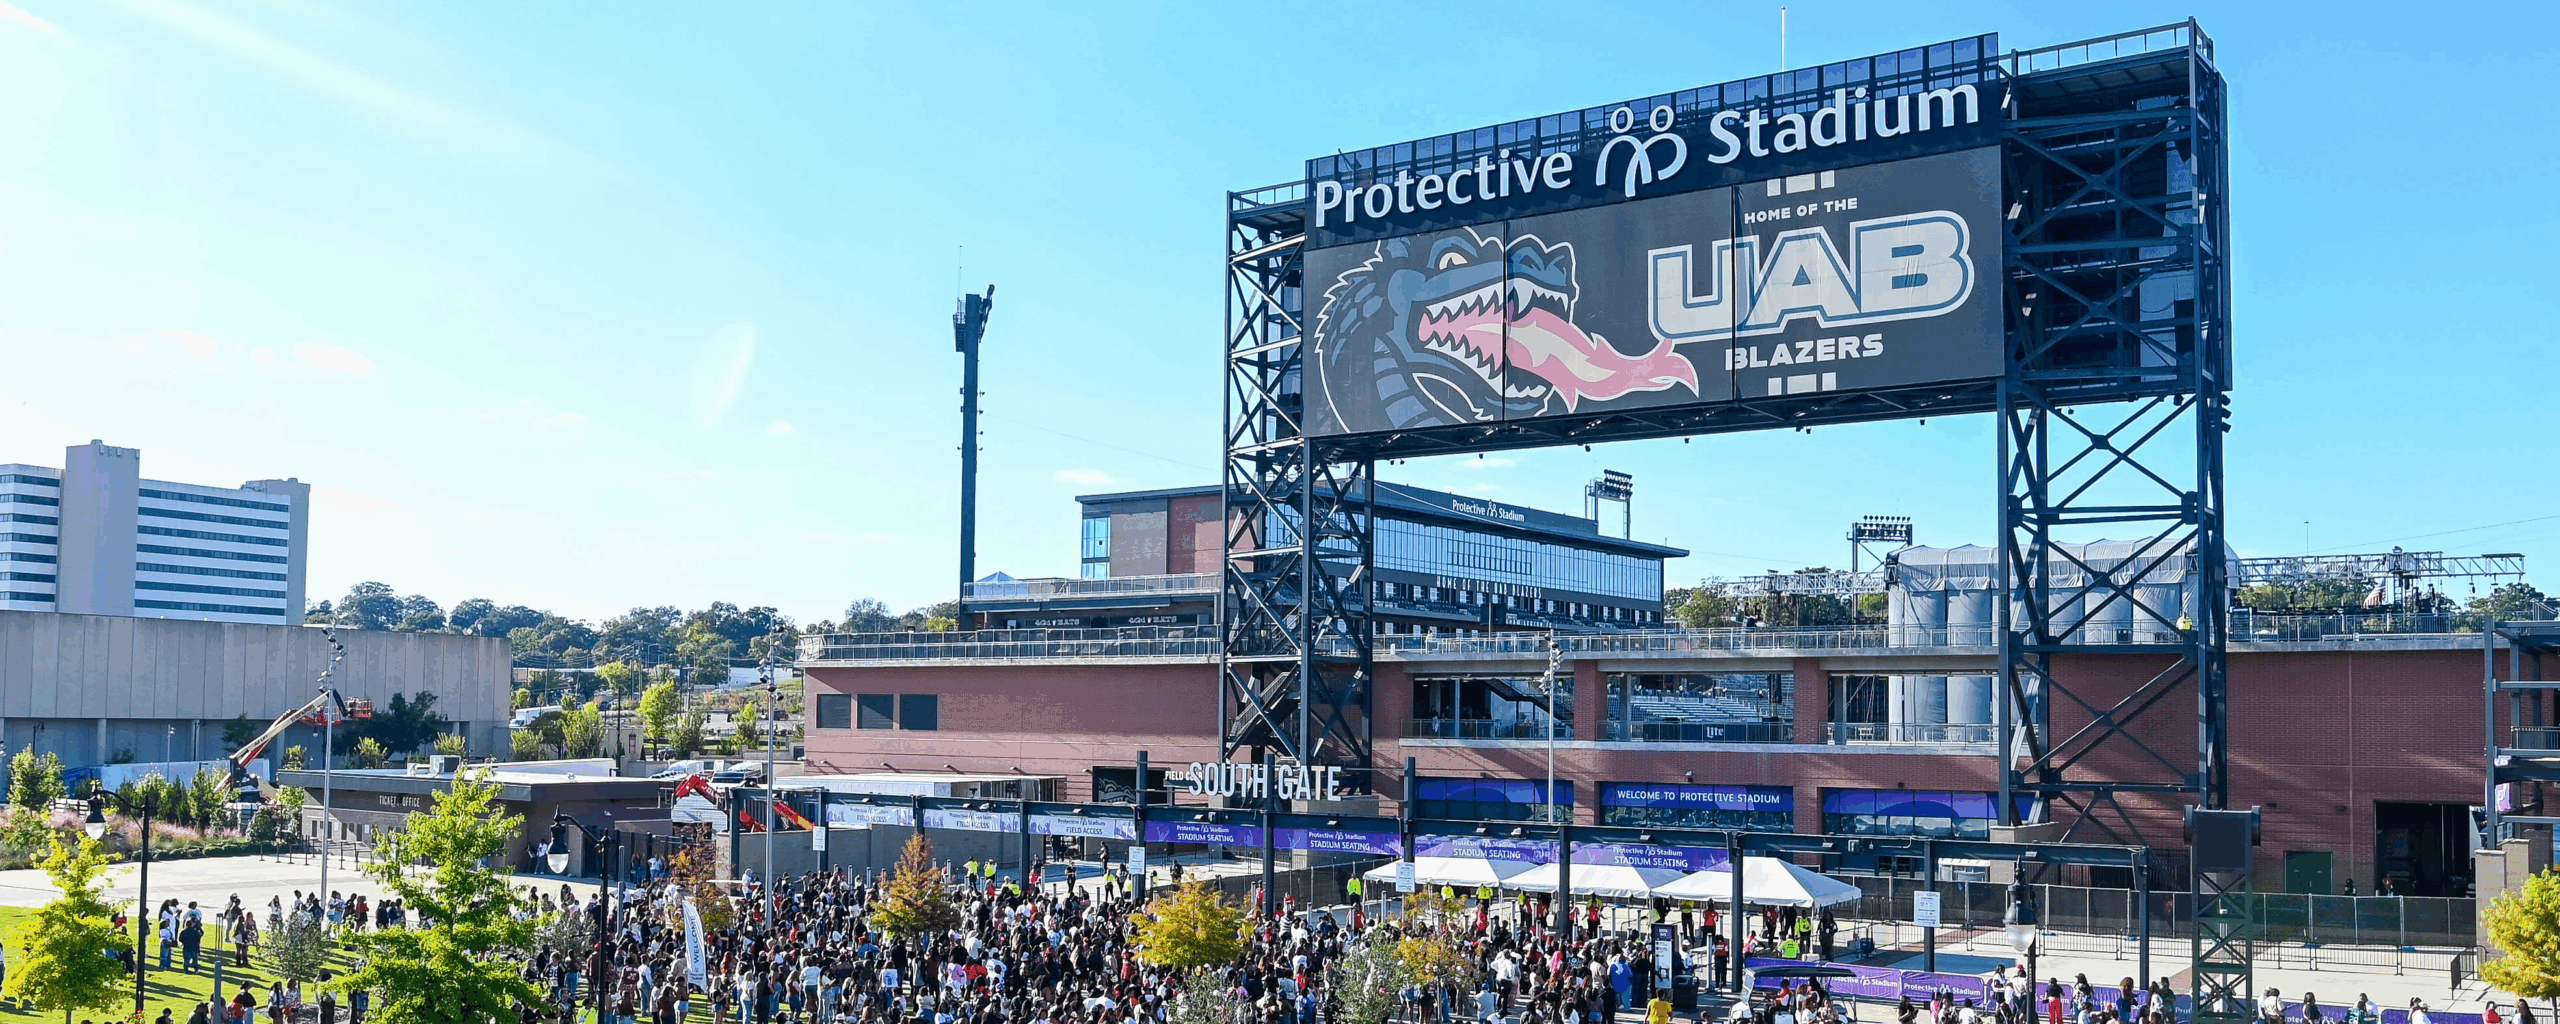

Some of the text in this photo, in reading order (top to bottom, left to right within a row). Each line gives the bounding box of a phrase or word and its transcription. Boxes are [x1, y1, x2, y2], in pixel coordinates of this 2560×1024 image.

[1315, 83, 1980, 228] Protective Stadium
[1744, 197, 1858, 225] HOME OF THE
[1648, 209, 1975, 344] UAB
[1725, 333, 1884, 370] BLAZERS
[1452, 499, 1525, 522] Protective Stadium
[1436, 575, 1457, 590] HOME
[1462, 578, 1471, 591] OF
[1476, 580, 1490, 593] THE
[1512, 584, 1542, 599] BLAZERS
[1706, 726, 1724, 739] Lite
[1165, 770, 1184, 781] FIELD
[1189, 761, 1342, 802] SOUTH GATE
[379, 795, 420, 808] TICKET OFFICE
[1617, 790, 1780, 804] WELCOME TO PROTECTIVE STADIUM
[1066, 826, 1103, 835] FIELD ACCESS
[1209, 825, 1230, 833] Stadium
[1177, 833, 1234, 843] STADIUM SEATING
[1309, 831, 1366, 841] Protective Stadium
[1310, 840, 1370, 851] STADIUM SEATING
[1612, 846, 1683, 857] Protective Stadium
[1453, 848, 1521, 859] STADIUM SEATING
[1614, 855, 1688, 868] STADIUM SEATING
[1871, 979, 1898, 987] Stadium
[1903, 983, 1981, 996] Protective Stadium
